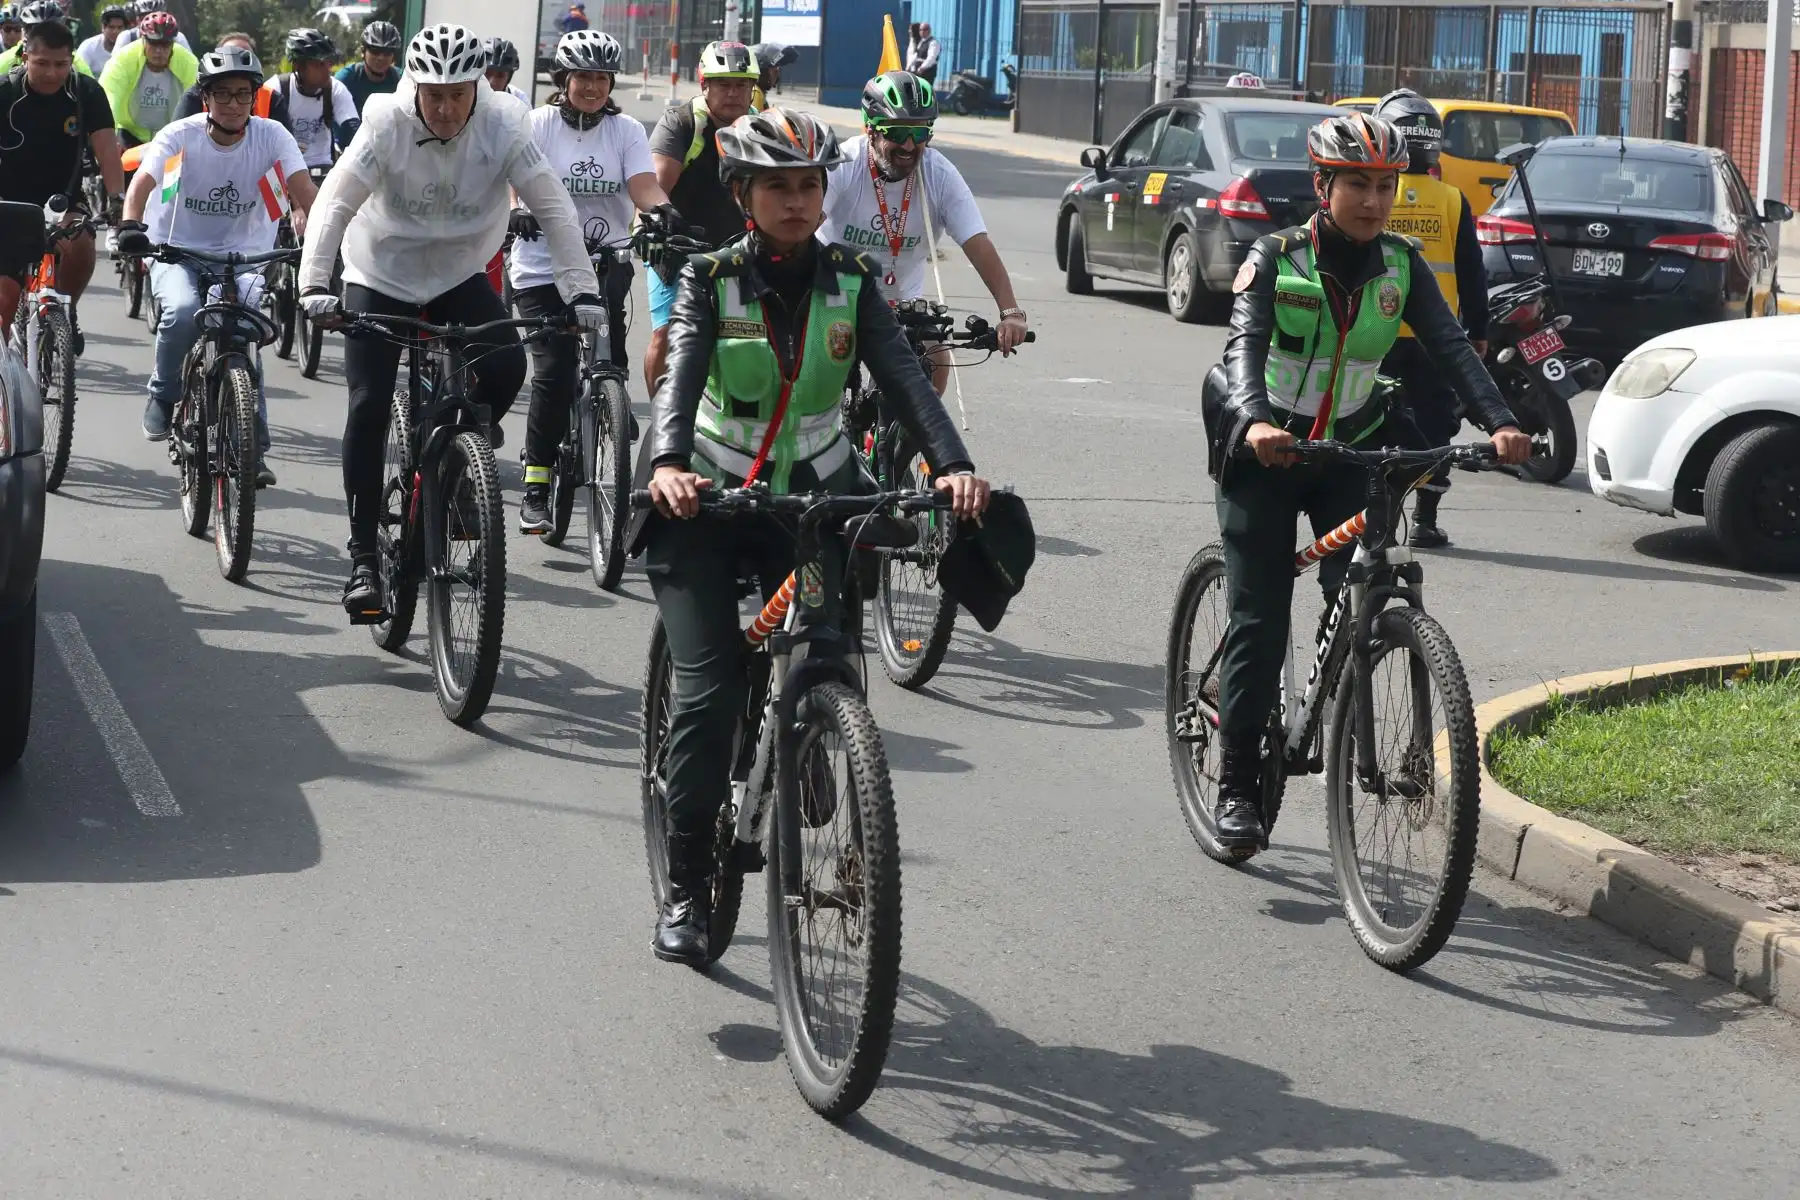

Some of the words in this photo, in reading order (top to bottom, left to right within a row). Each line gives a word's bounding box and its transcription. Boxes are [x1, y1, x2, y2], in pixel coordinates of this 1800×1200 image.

[1237, 77, 1260, 87] TAXI
[896, 210, 907, 238] TOURING
[1386, 219, 1440, 234] SERENAZGO
[843, 223, 922, 248] BICICLTEA
[1574, 254, 1622, 273] BDW-199
[1523, 333, 1560, 359] EU-1112
[1547, 360, 1562, 377] 5
